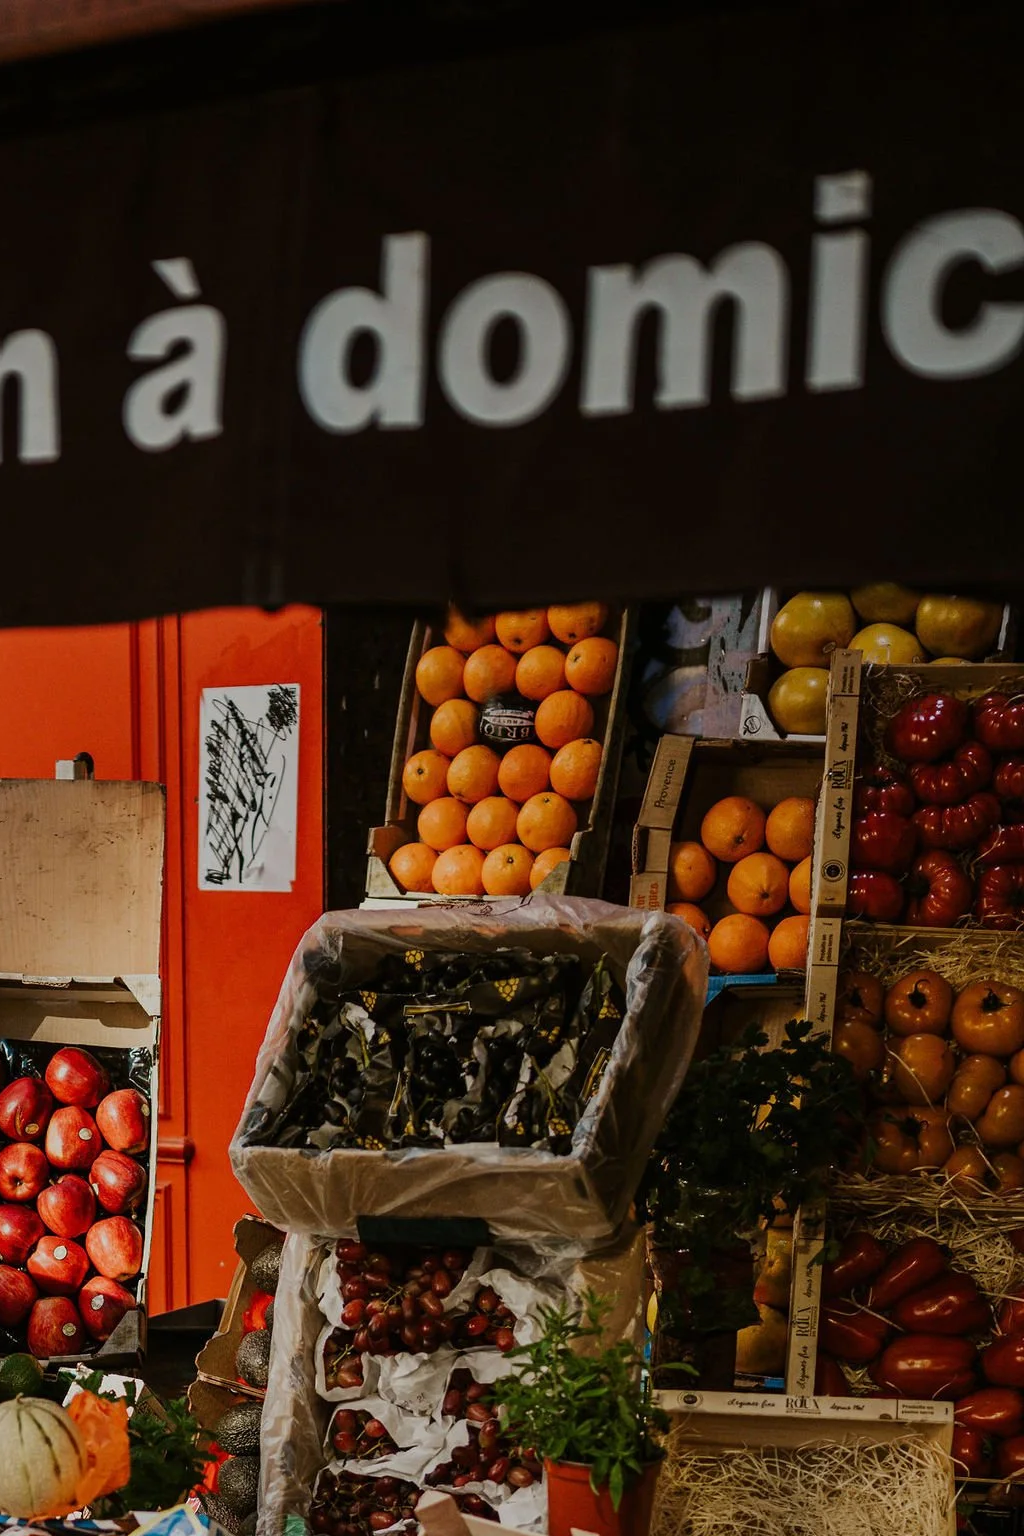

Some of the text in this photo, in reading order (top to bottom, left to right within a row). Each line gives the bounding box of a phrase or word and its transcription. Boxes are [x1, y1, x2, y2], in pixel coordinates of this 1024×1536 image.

[122, 256, 226, 452] à
[298, 171, 1024, 435] domic
[484, 723, 530, 738] BRIO
[654, 759, 676, 808] Provence
[831, 760, 847, 789] ROUX
[785, 1397, 820, 1409] ROUX
